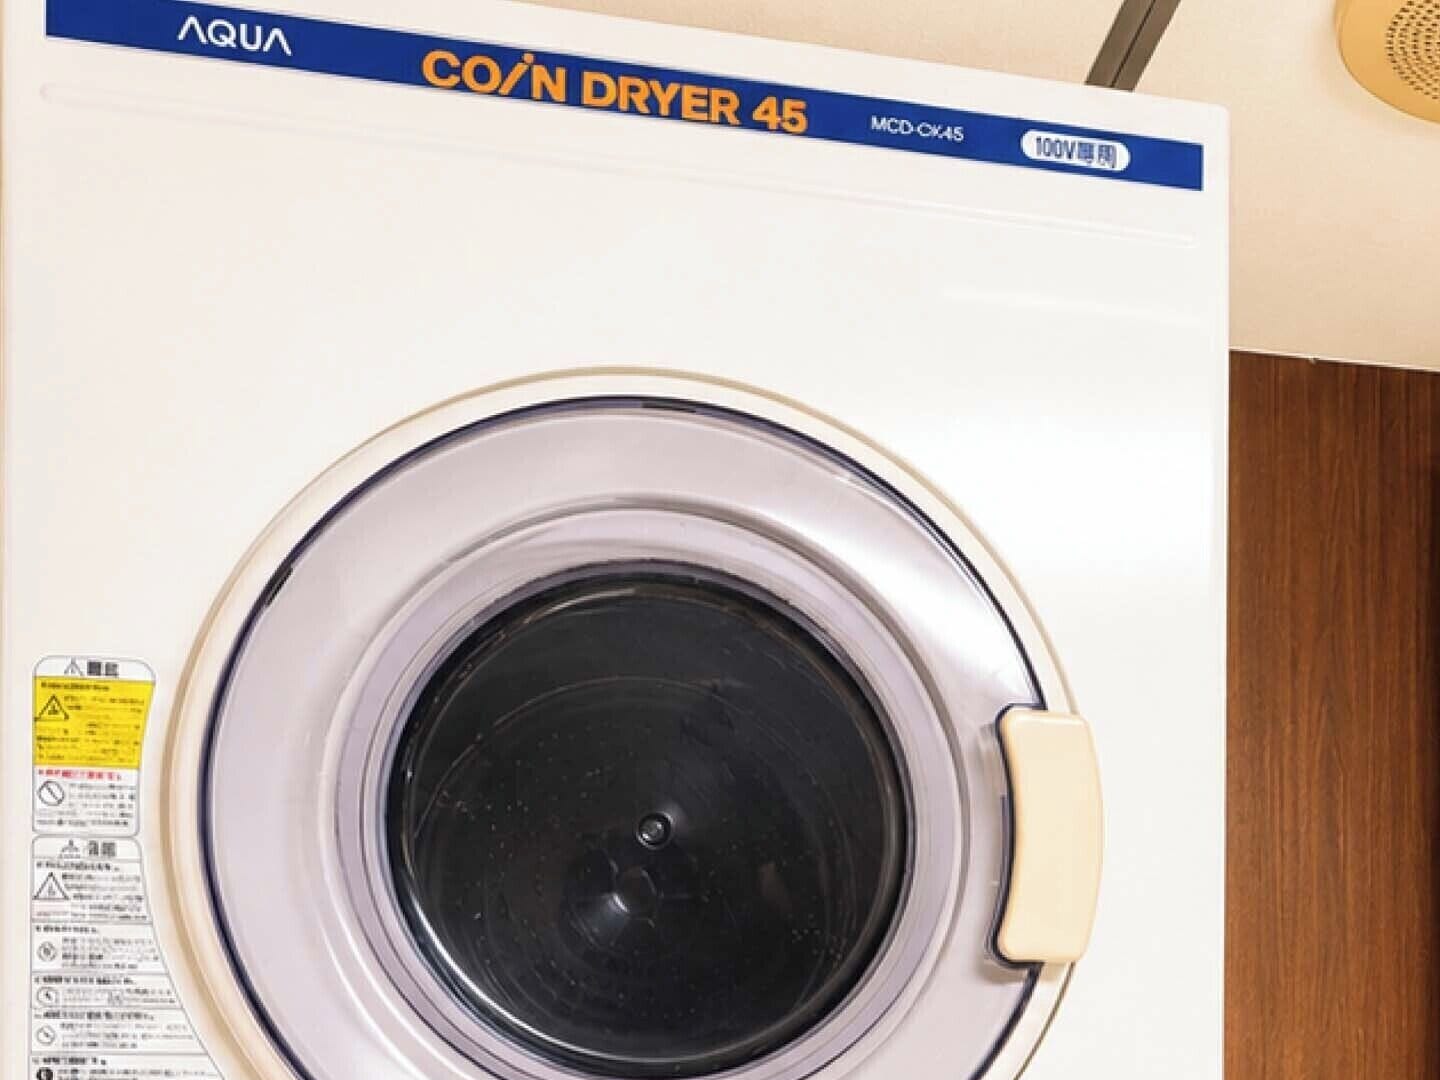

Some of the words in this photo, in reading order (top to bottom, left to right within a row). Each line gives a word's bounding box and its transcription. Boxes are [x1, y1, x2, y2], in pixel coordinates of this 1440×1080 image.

[177, 15, 292, 56] AQUA
[580, 70, 740, 126] DRYER
[752, 95, 809, 134] 45
